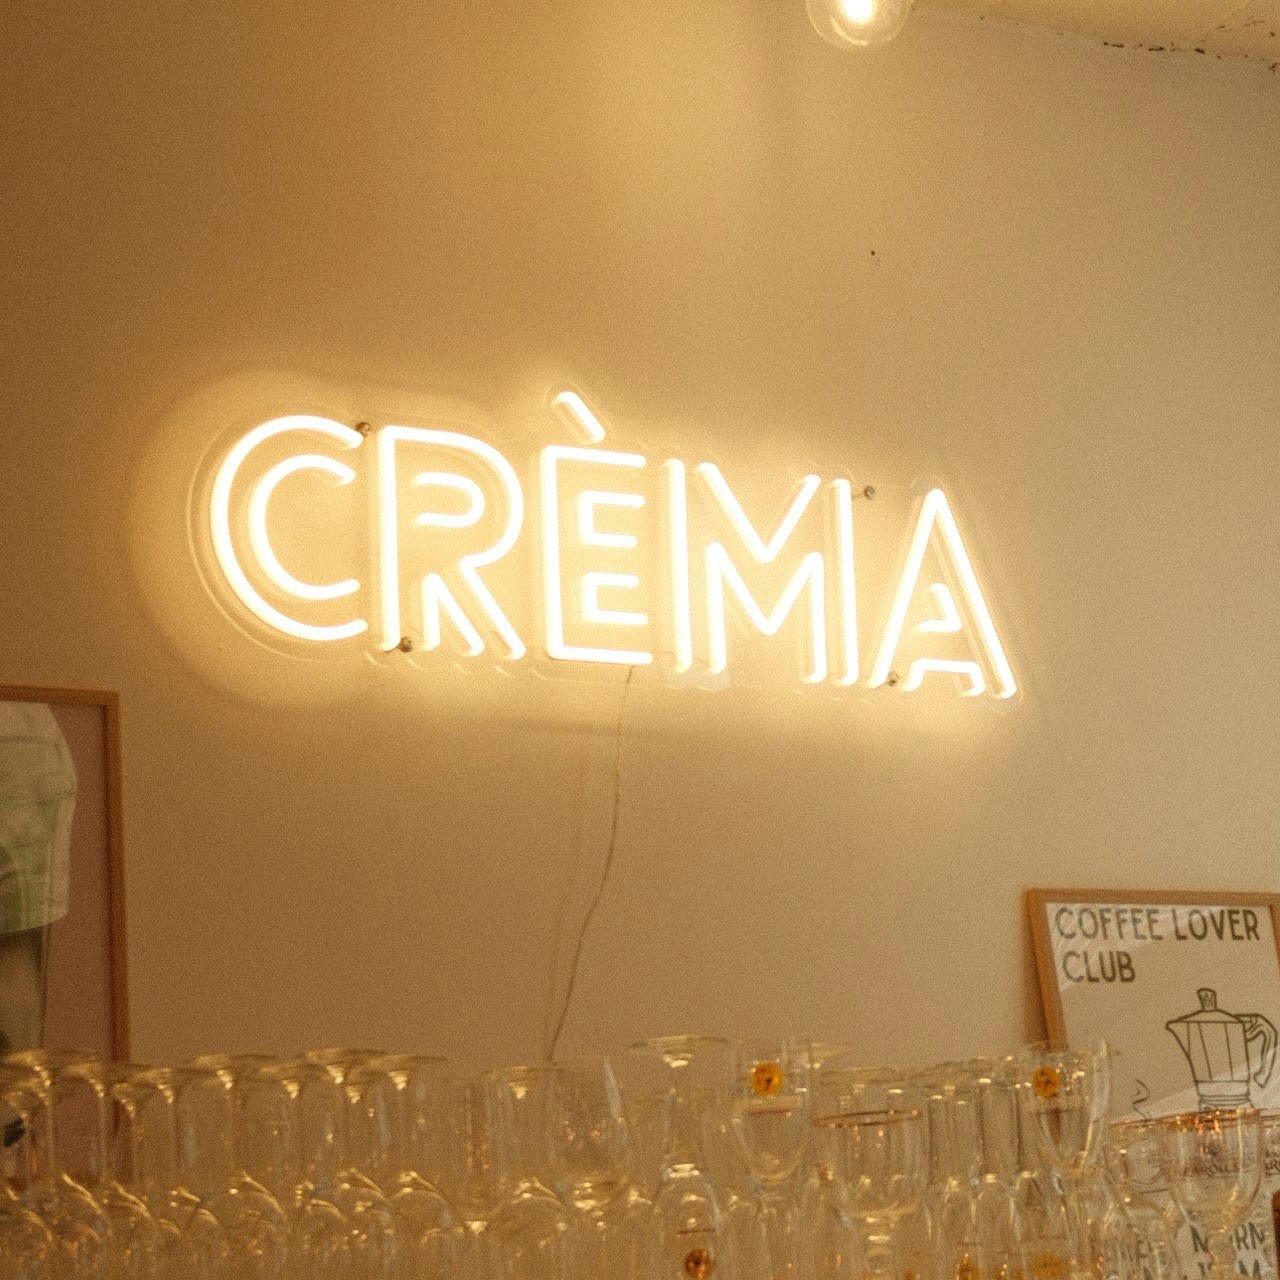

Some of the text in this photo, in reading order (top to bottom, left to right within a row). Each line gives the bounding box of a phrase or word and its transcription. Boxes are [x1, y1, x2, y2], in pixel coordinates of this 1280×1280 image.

[208, 390, 1018, 700] CRÈMA
[1055, 907, 1260, 941] COFFEE LOVER
[1061, 950, 1137, 983] CLUB
